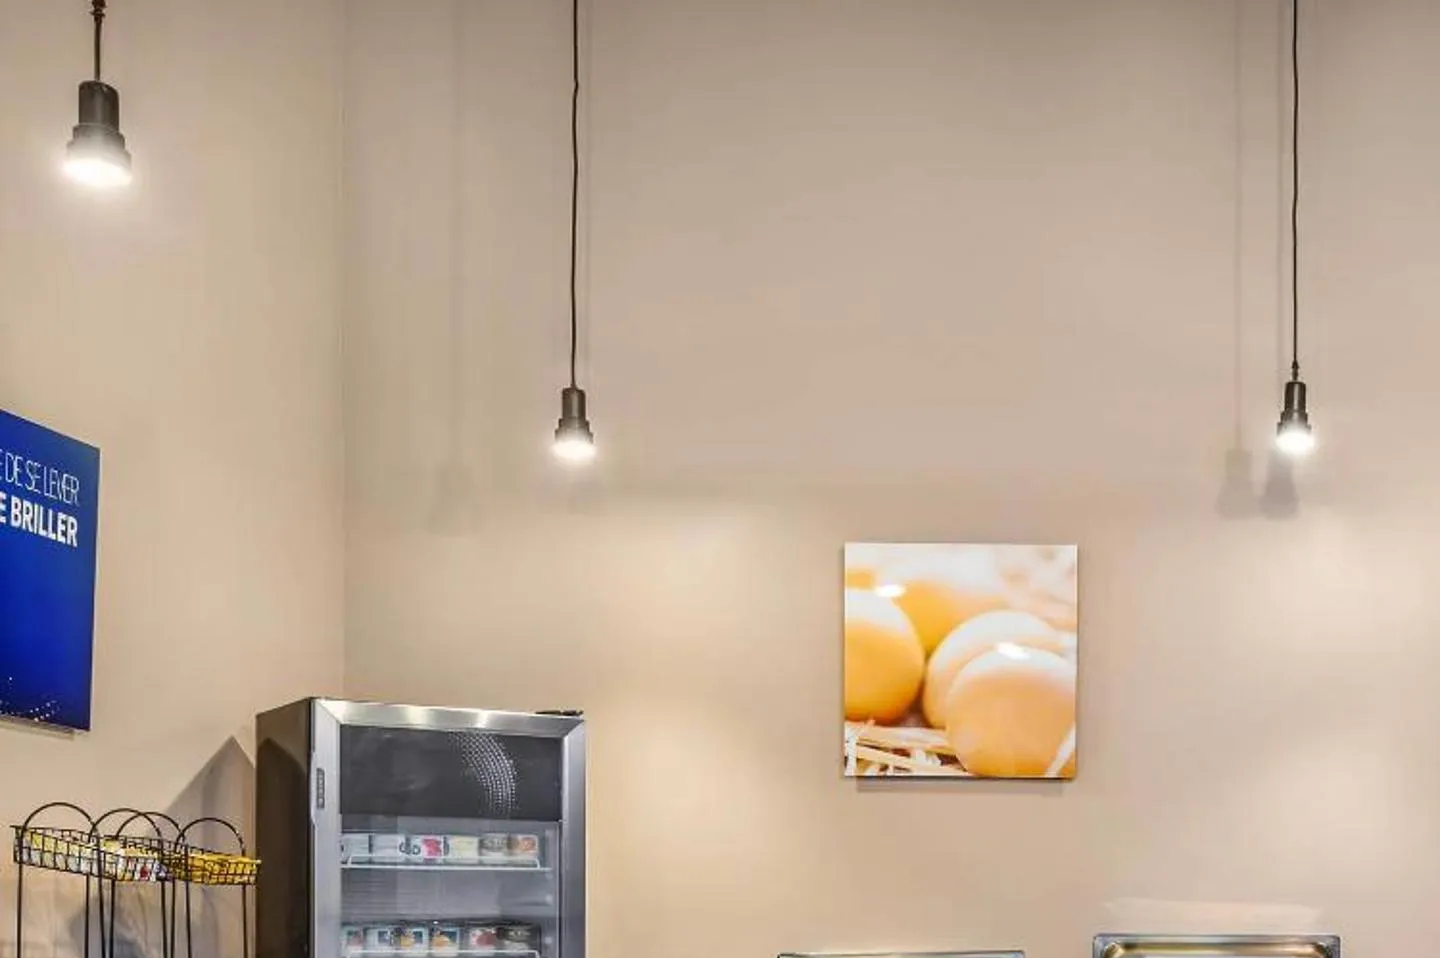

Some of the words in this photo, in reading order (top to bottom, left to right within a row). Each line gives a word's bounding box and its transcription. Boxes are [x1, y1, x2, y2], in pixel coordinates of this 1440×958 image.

[5, 452, 24, 487] DE
[25, 460, 42, 494] SE
[43, 466, 80, 507] LEVER
[11, 495, 78, 547] BRILLER
